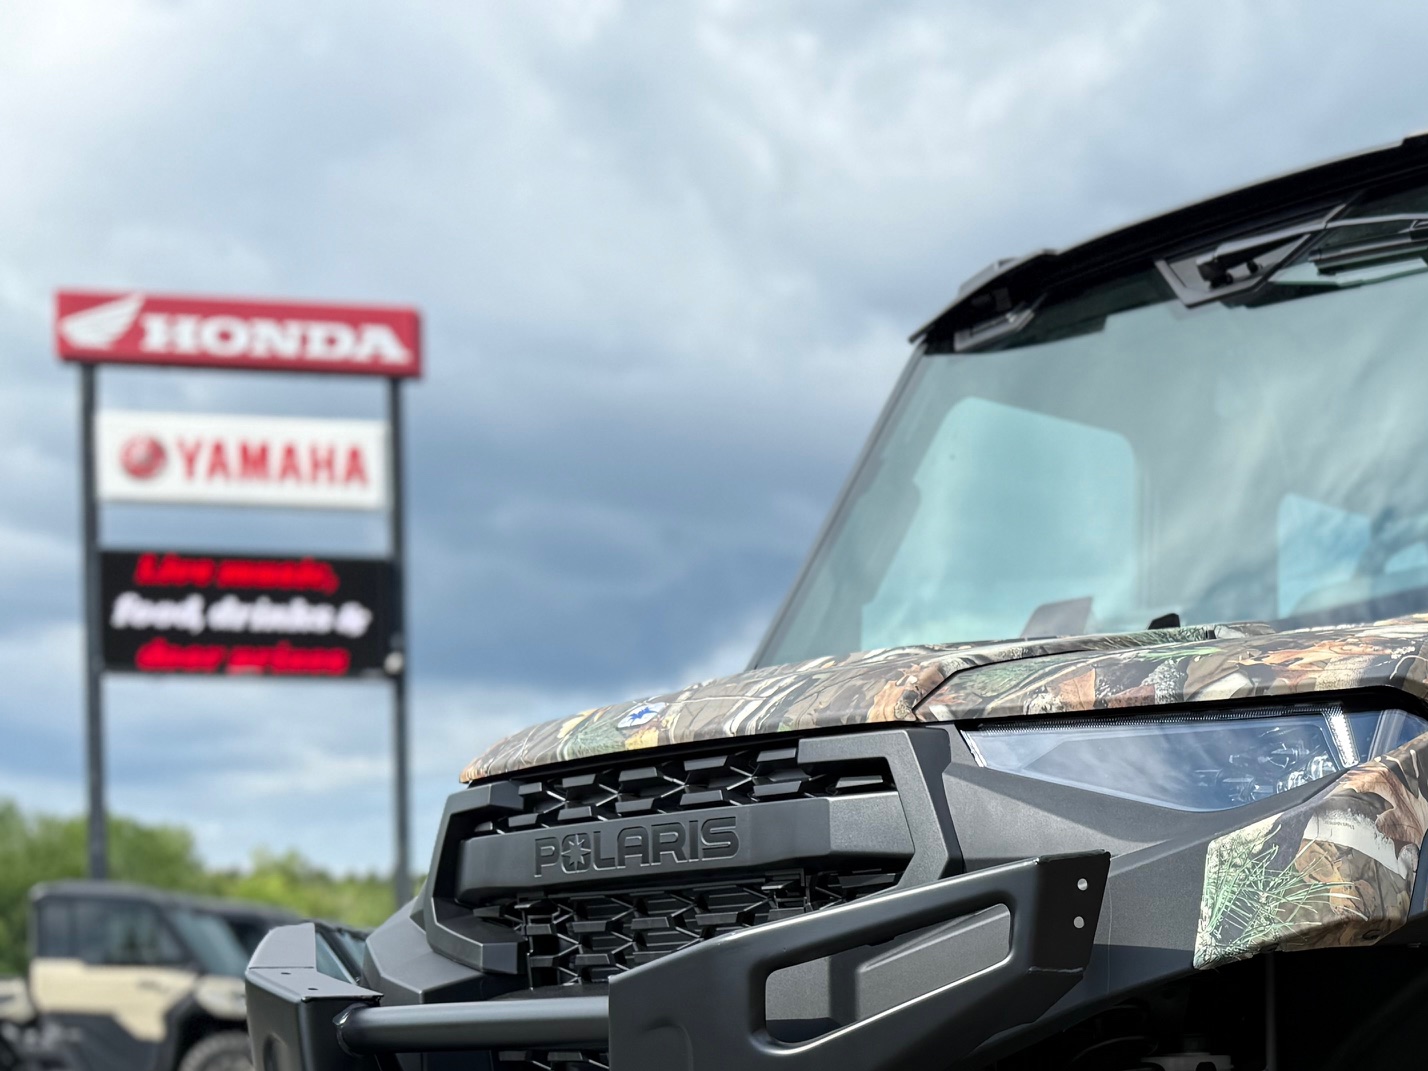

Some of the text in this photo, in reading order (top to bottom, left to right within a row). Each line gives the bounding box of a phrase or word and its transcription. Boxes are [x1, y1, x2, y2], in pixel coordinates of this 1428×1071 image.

[140, 312, 411, 365] HONDA
[176, 435, 370, 488] YAMAHA
[206, 595, 335, 633] drinks
[534, 816, 740, 878] POLARIS
